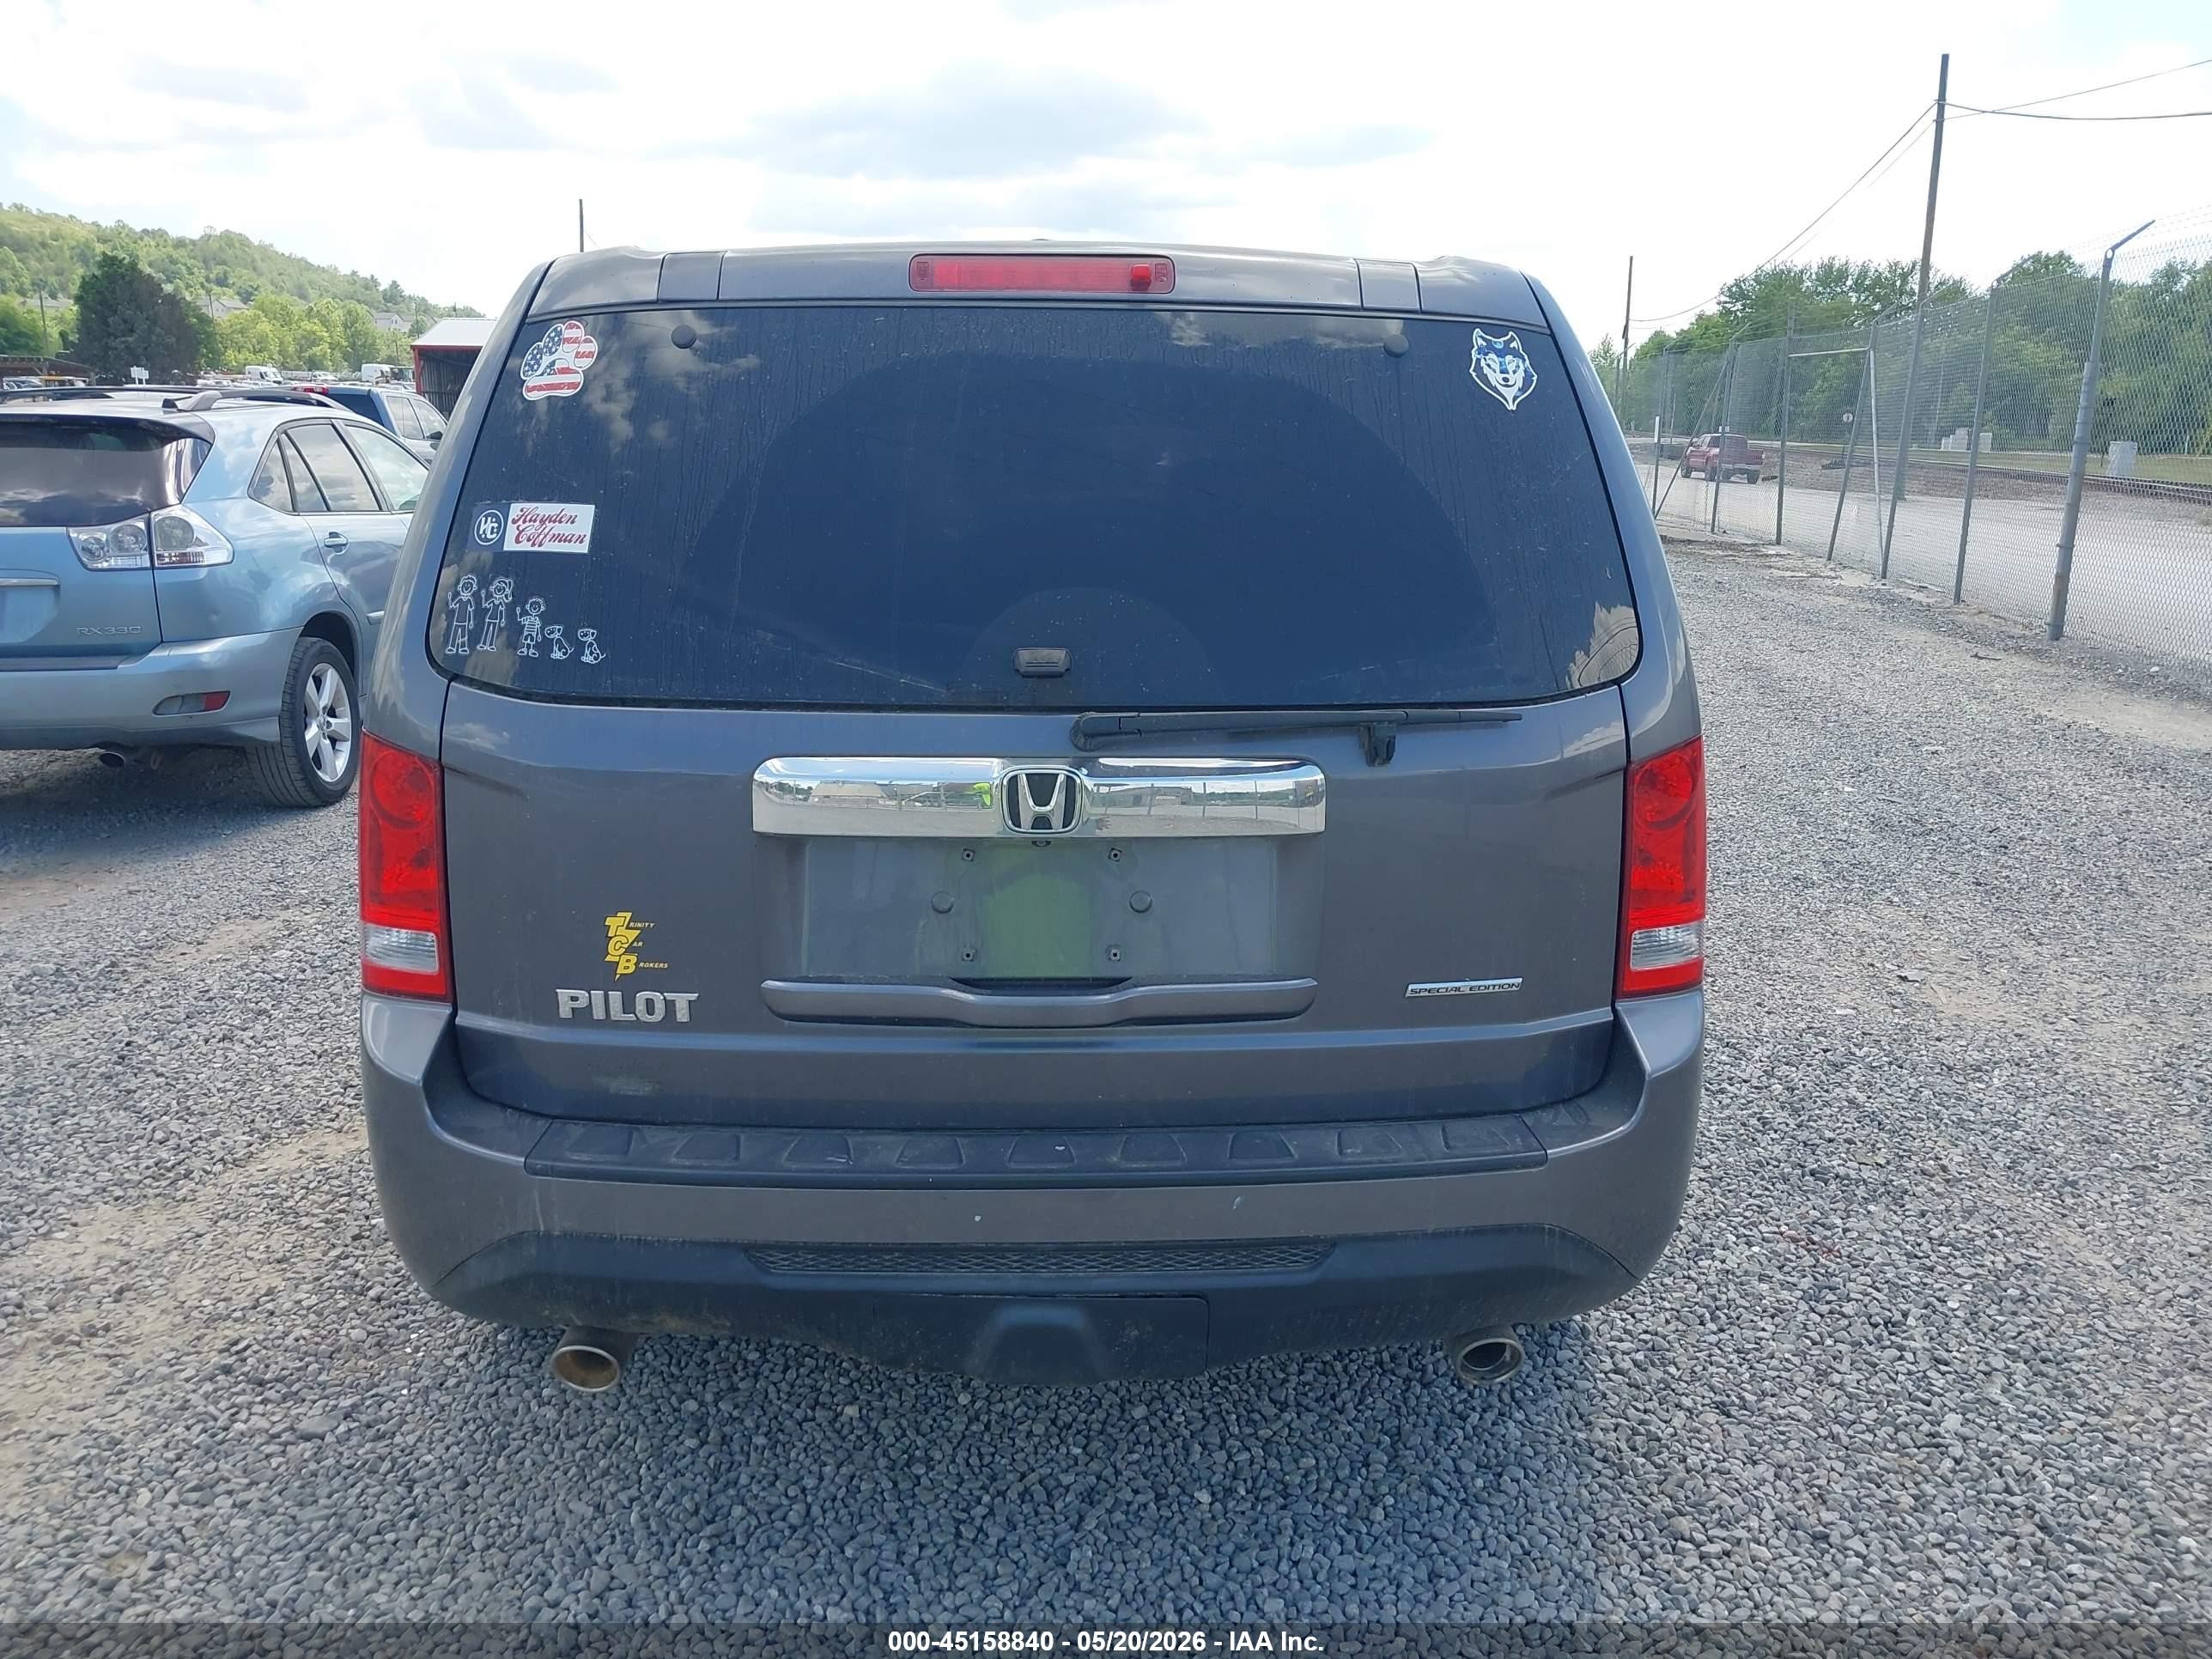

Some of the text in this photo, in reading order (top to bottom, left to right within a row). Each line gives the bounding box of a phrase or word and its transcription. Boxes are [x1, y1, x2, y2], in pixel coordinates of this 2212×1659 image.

[511, 507, 578, 532] Hayden
[514, 525, 586, 548] Coffman
[1410, 982, 1520, 995] SPECIAL EDITION
[556, 988, 699, 1023] PILOT
